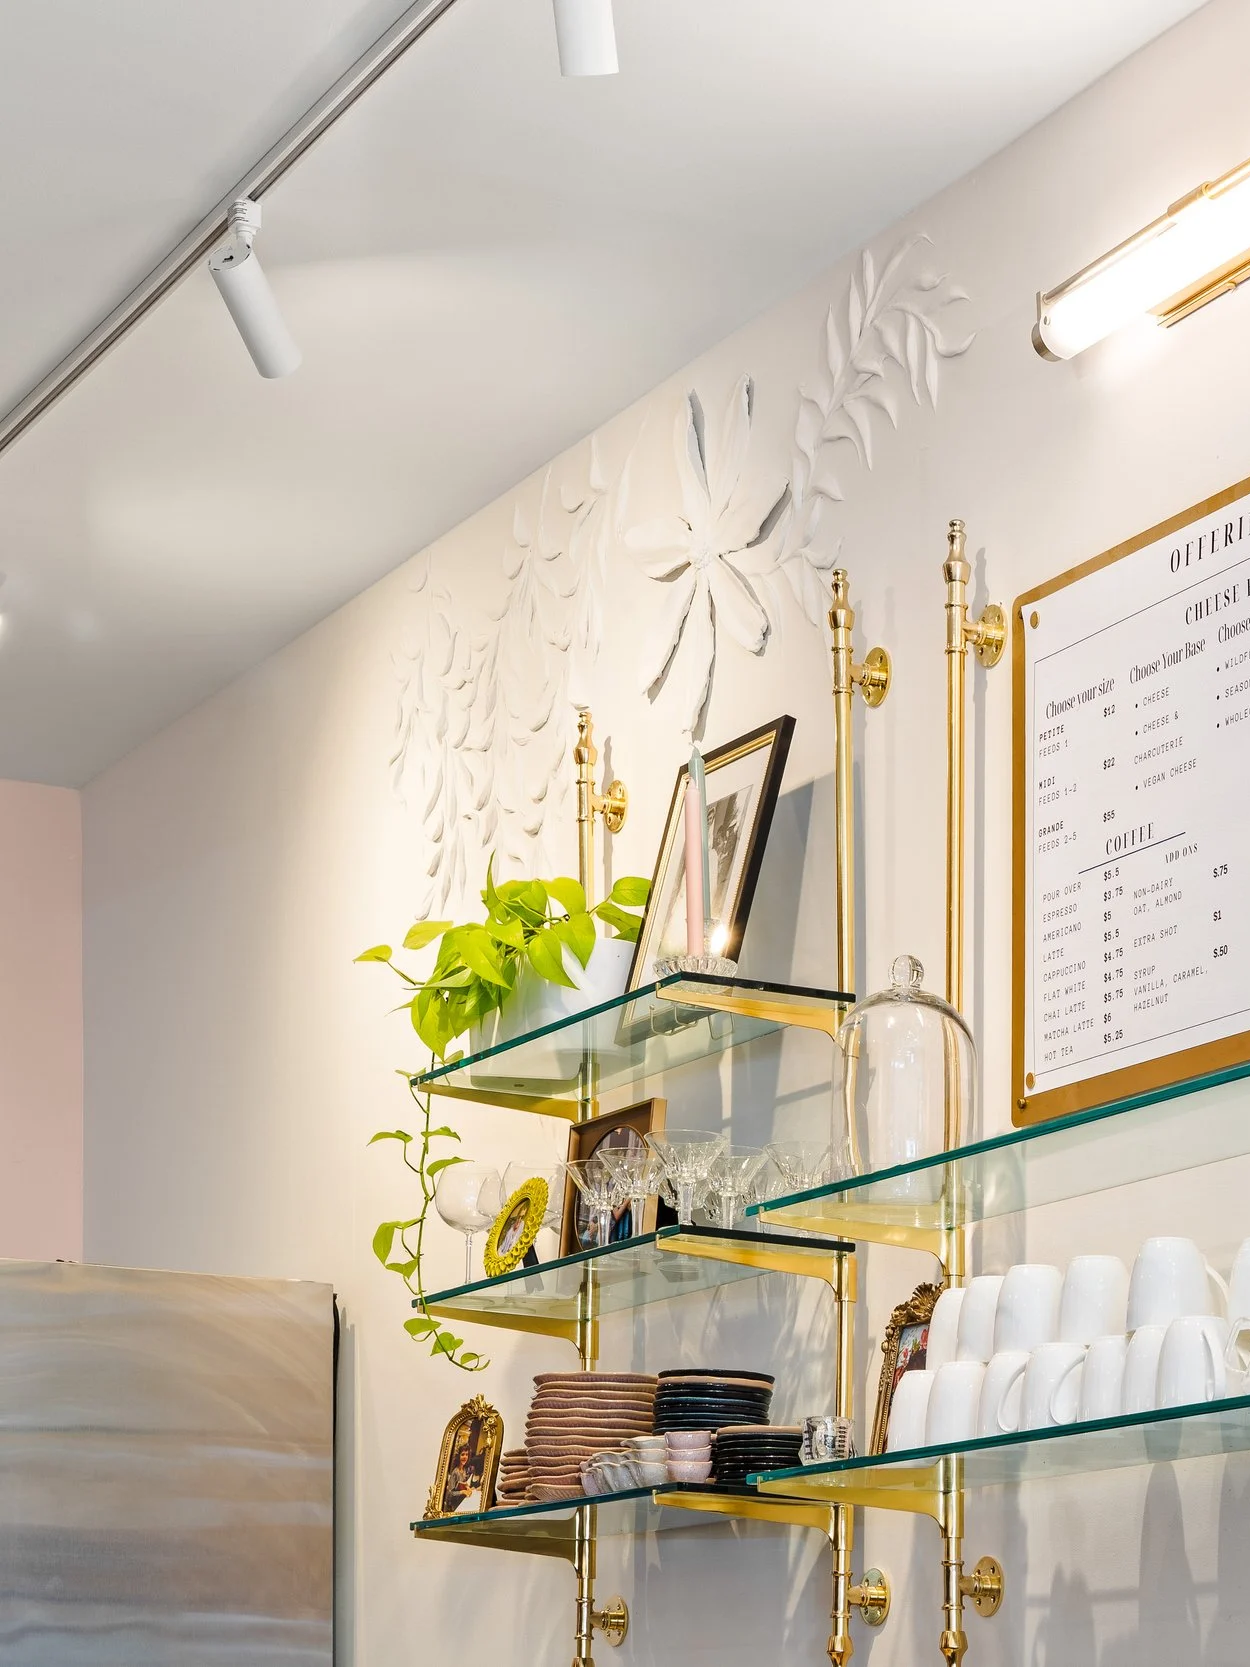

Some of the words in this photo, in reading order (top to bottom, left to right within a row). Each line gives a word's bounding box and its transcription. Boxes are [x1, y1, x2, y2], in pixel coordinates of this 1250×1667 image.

[1185, 584, 1240, 626] CHEESE
[1218, 617, 1250, 644] Choose
[1129, 660, 1161, 684] Choose
[1162, 648, 1184, 670] Your
[1184, 638, 1206, 660] Base
[1046, 696, 1076, 720] Choose
[1076, 686, 1098, 712] your
[1098, 678, 1116, 696] size
[1142, 686, 1170, 706] CHEESE
[1038, 724, 1065, 742] PETITE
[1104, 704, 1116, 718] $12
[1142, 714, 1170, 734] CHEESE
[1174, 710, 1180, 720] &
[1038, 742, 1060, 758] FEEDS
[1134, 736, 1184, 766] CHARCUTERIE
[1038, 776, 1056, 790] MIDI
[1103, 756, 1116, 770] $22
[1142, 772, 1166, 788] VEGAN
[1169, 758, 1198, 778] CHEESE
[1038, 790, 1060, 806] FEEDS
[1064, 782, 1078, 796] 1-2
[1038, 820, 1064, 838] GRANDE
[1103, 810, 1116, 823] $55
[1106, 822, 1154, 856] COFFEE
[1038, 837, 1060, 854] FEEDS
[1064, 831, 1078, 844] 2-5
[1042, 888, 1060, 903] POUR
[1064, 881, 1082, 896] OVER
[1104, 866, 1120, 882] $5.5
[1133, 876, 1174, 900] NON-DAIRY
[1212, 864, 1228, 878] $.75
[1155, 890, 1183, 908] ALMOND
[1042, 903, 1078, 923] ESPRESSO
[1104, 886, 1124, 902] $3.75
[1042, 922, 1082, 944] AMERICANO
[1104, 910, 1112, 922] $5
[1133, 933, 1156, 948] EXTRA
[1159, 924, 1178, 939] SHOT
[1212, 910, 1222, 922] $1
[1042, 948, 1064, 963] LATTE
[1104, 928, 1120, 942] $5.5
[1133, 964, 1156, 980] SYRUP
[1212, 944, 1228, 959] $.50
[1043, 960, 1086, 983] CAPPUCCINO
[1104, 947, 1124, 963] $4.75
[1043, 988, 1061, 1002] FLAT
[1064, 980, 1086, 996] WHITE
[1104, 968, 1124, 984] $4.75
[1043, 1008, 1061, 1023] CHAI
[1064, 1000, 1086, 1016] LATTE
[1104, 988, 1124, 1004] $5.75
[1133, 992, 1169, 1014] HAZELNUT
[1044, 1026, 1070, 1042] MATCHA
[1073, 1018, 1094, 1033] LATTE
[1104, 1012, 1112, 1024] $6
[1044, 1049, 1057, 1062] HOT
[1060, 1046, 1074, 1056] TEA
[1104, 1029, 1124, 1044] $5.25
